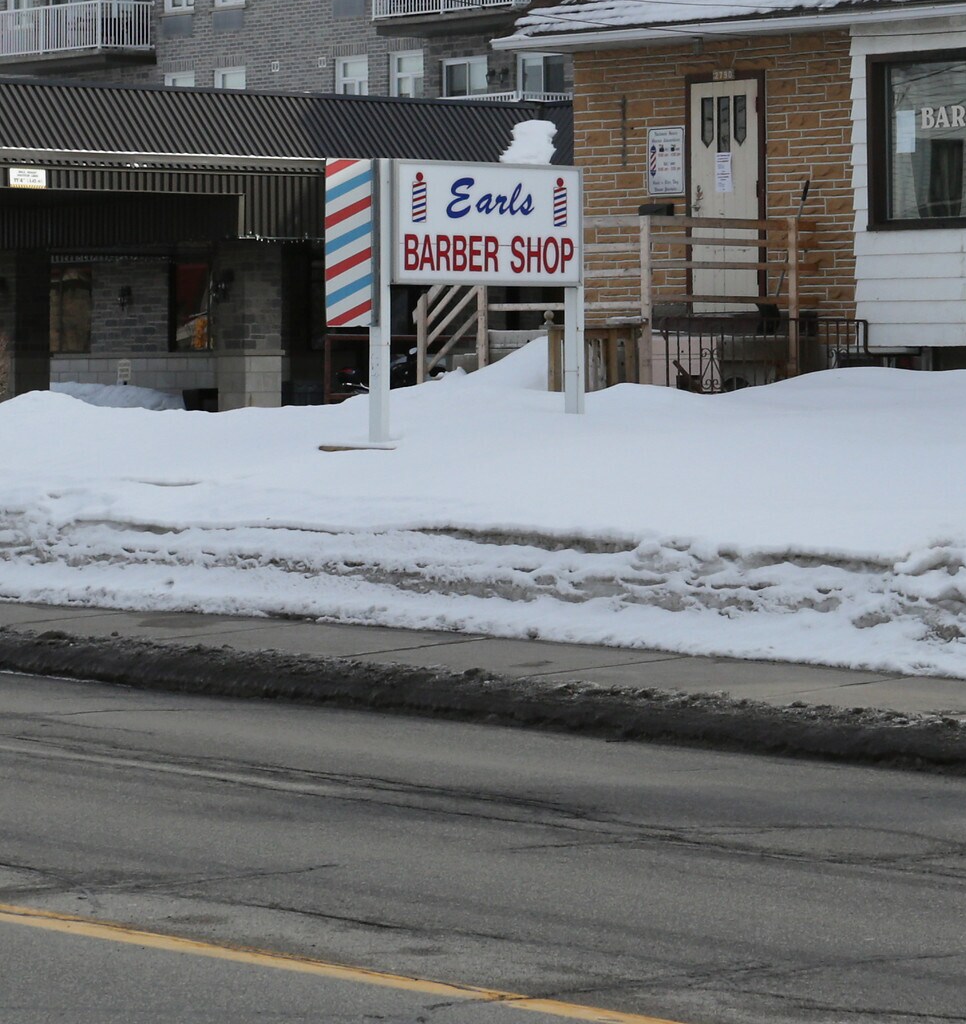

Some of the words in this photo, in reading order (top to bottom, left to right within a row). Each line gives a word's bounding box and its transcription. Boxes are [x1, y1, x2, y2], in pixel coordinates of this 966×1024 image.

[446, 177, 535, 219] Earls
[404, 233, 499, 272] BARBER
[510, 235, 575, 274] SHOP
